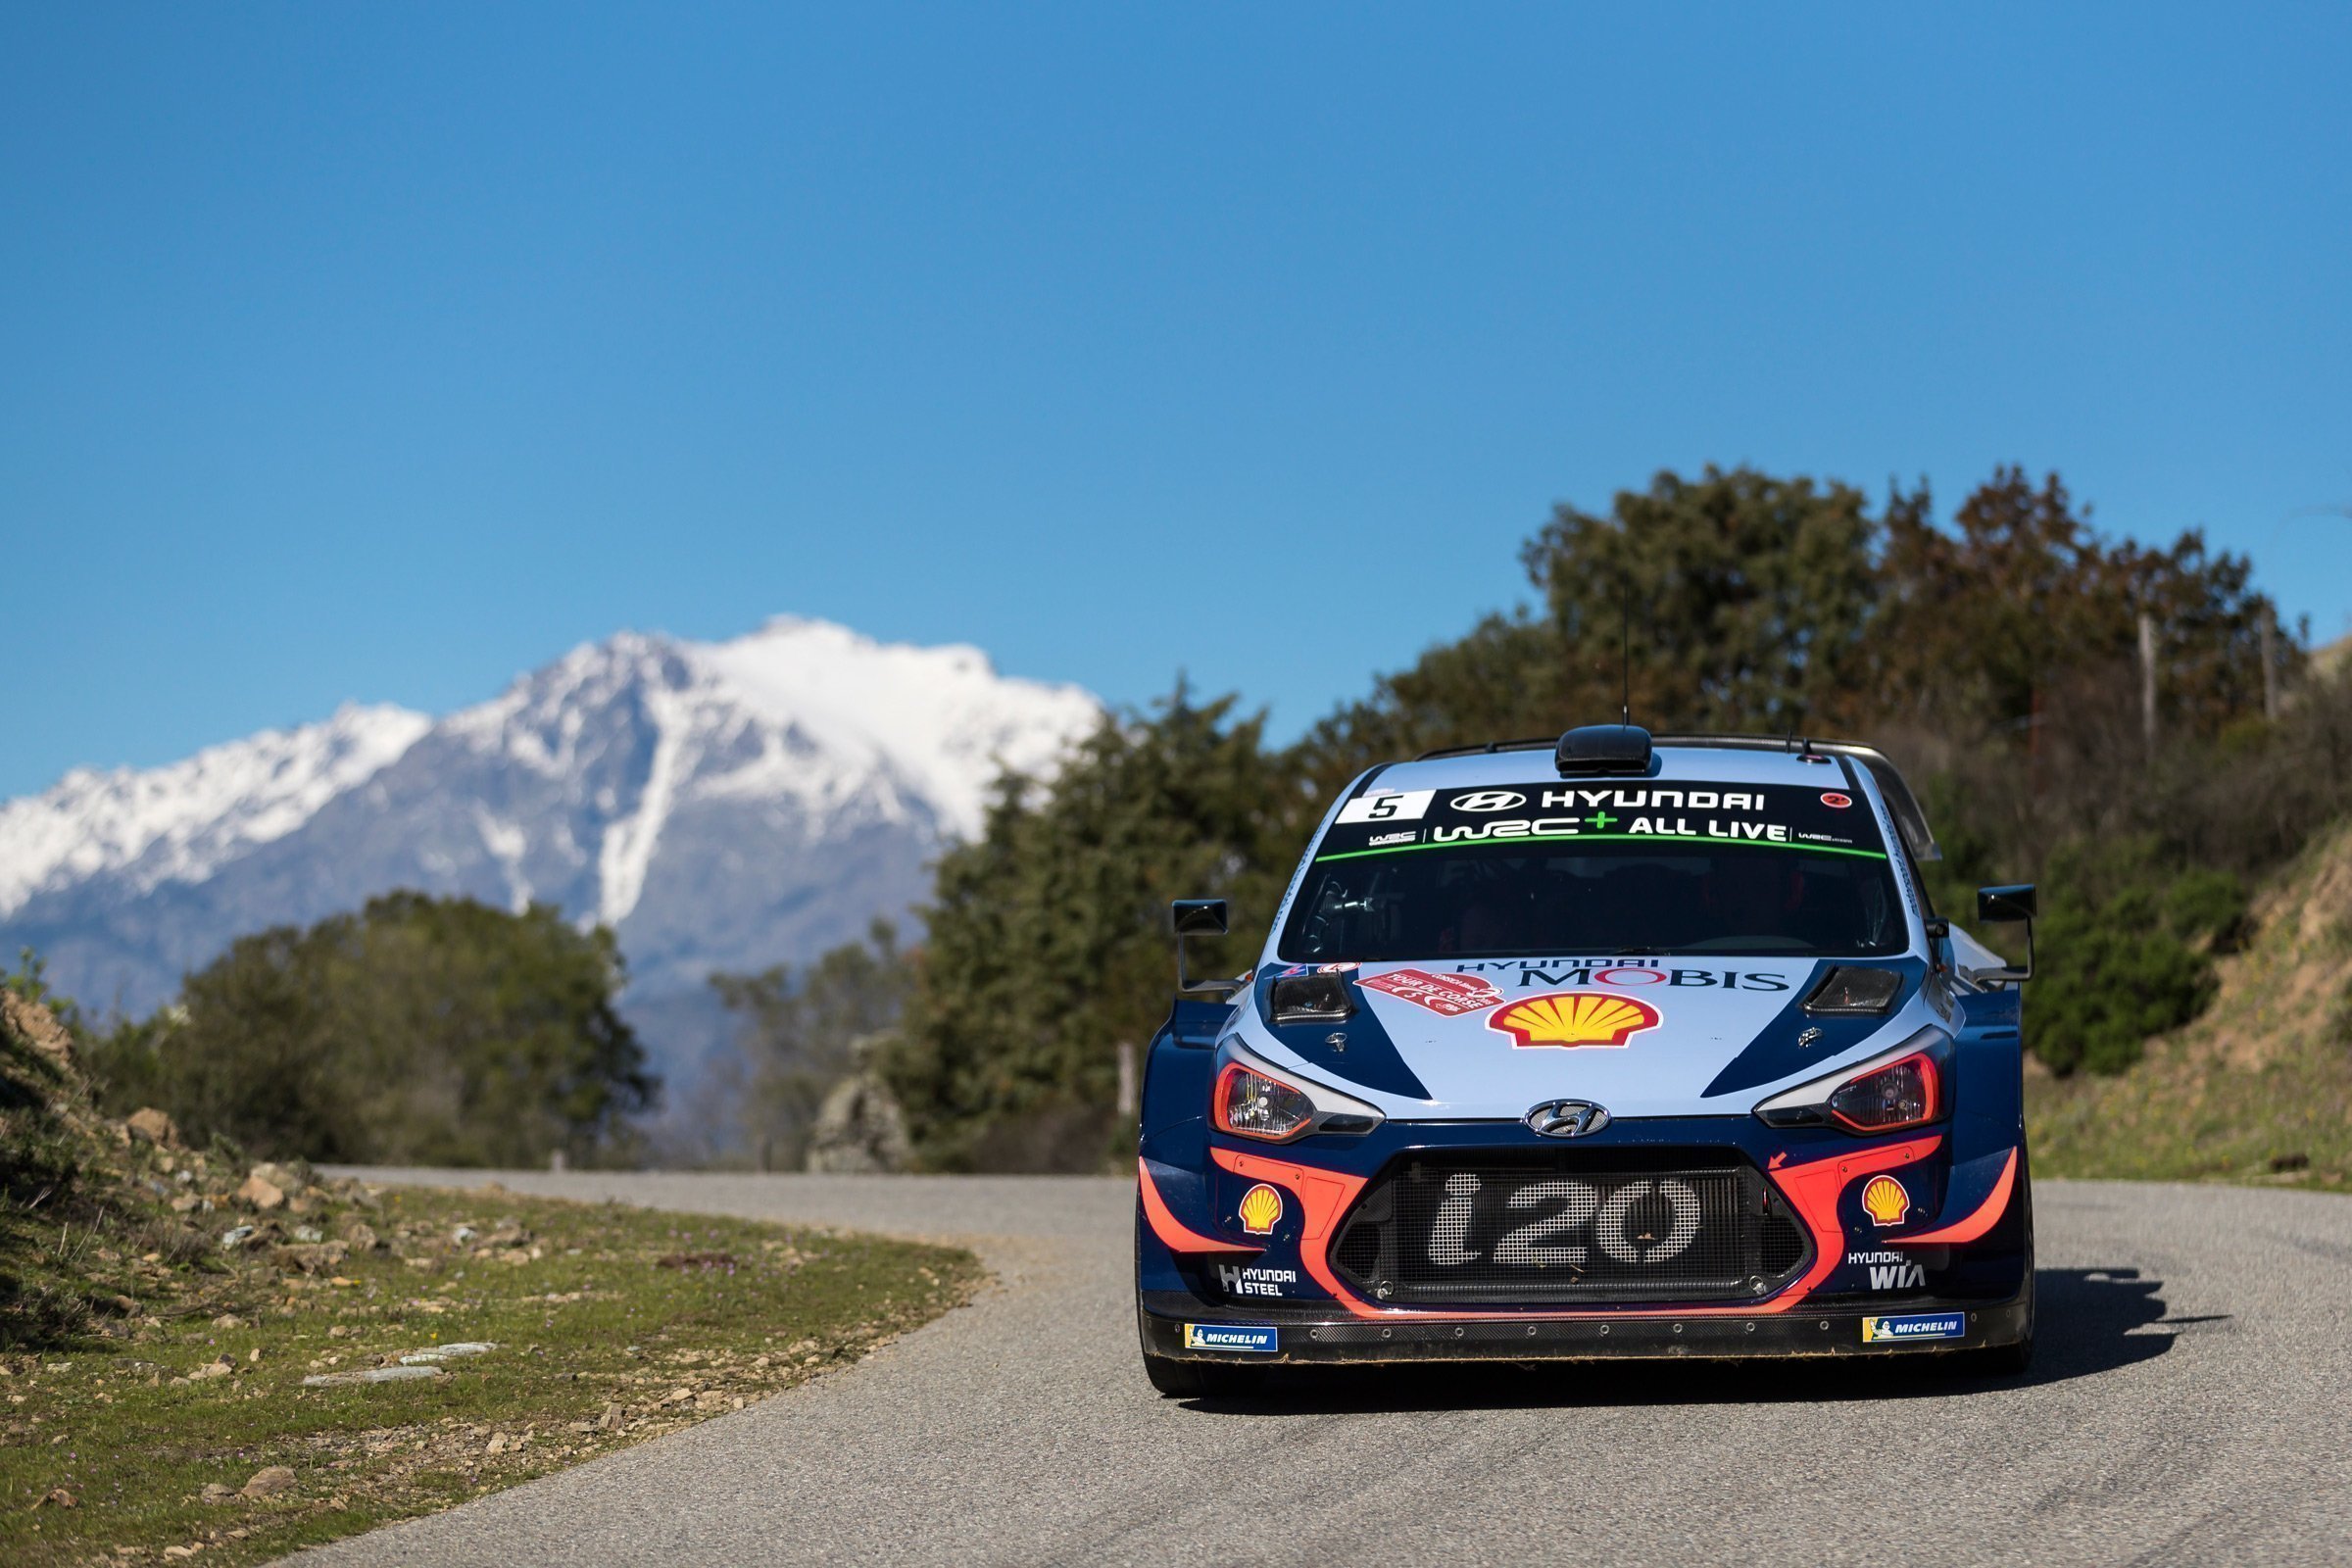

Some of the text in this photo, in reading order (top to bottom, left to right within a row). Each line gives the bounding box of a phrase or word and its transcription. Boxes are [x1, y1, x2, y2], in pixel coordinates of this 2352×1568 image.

[1368, 795, 1403, 819] 5
[1542, 790, 1765, 810] HYUNDAI
[1628, 816, 1696, 836] ALL
[1708, 819, 1788, 842] LIVE
[1456, 959, 1659, 973] HYUNDAI
[1516, 967, 1790, 992] MOBIS
[1418, 984, 1443, 993] DE
[1438, 991, 1484, 1009] CORSE
[1428, 1173, 1700, 1266] i20
[1848, 1251, 1904, 1264] HYUNDAI
[1242, 1268, 1297, 1283] HYUNDAI
[1244, 1282, 1283, 1297] STEEL
[1894, 1320, 1958, 1334] MICHELIN
[1205, 1332, 1268, 1345] MICHELIN
